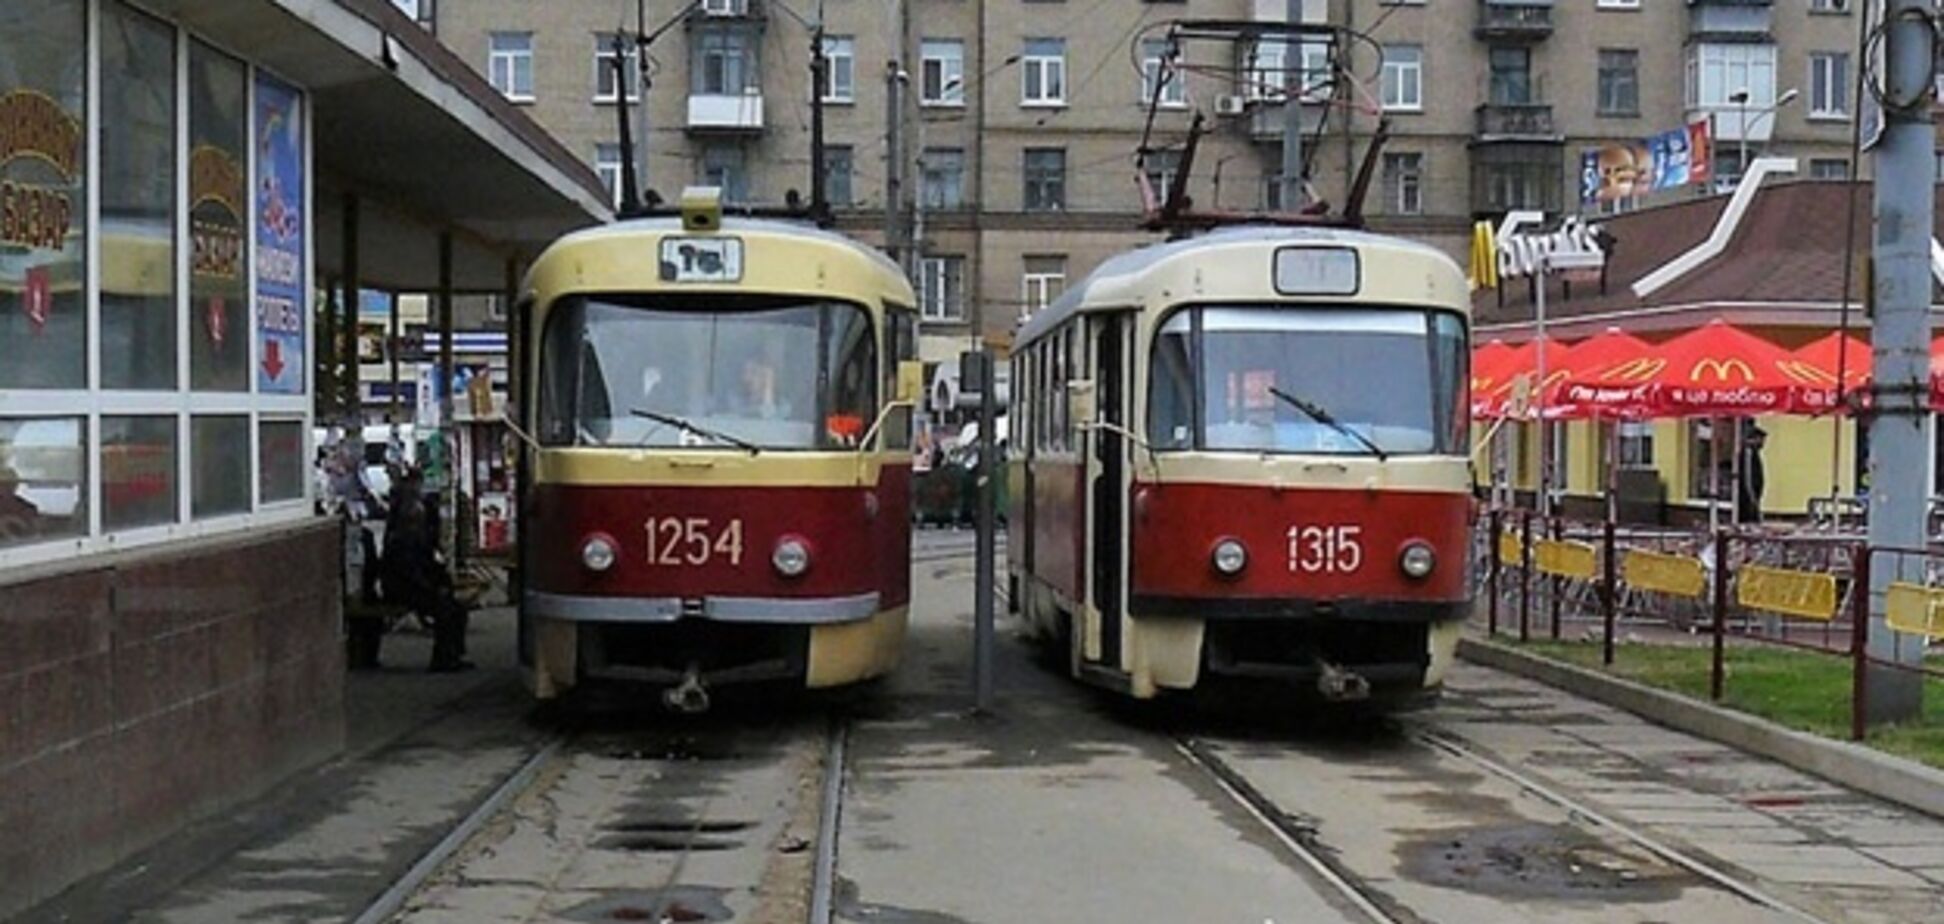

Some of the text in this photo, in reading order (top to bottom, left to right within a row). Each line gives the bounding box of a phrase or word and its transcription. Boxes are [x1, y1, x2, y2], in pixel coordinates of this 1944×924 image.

[1711, 385, 1776, 405] люблю
[644, 517, 742, 565] 1254
[1286, 525, 1361, 572] 1315
